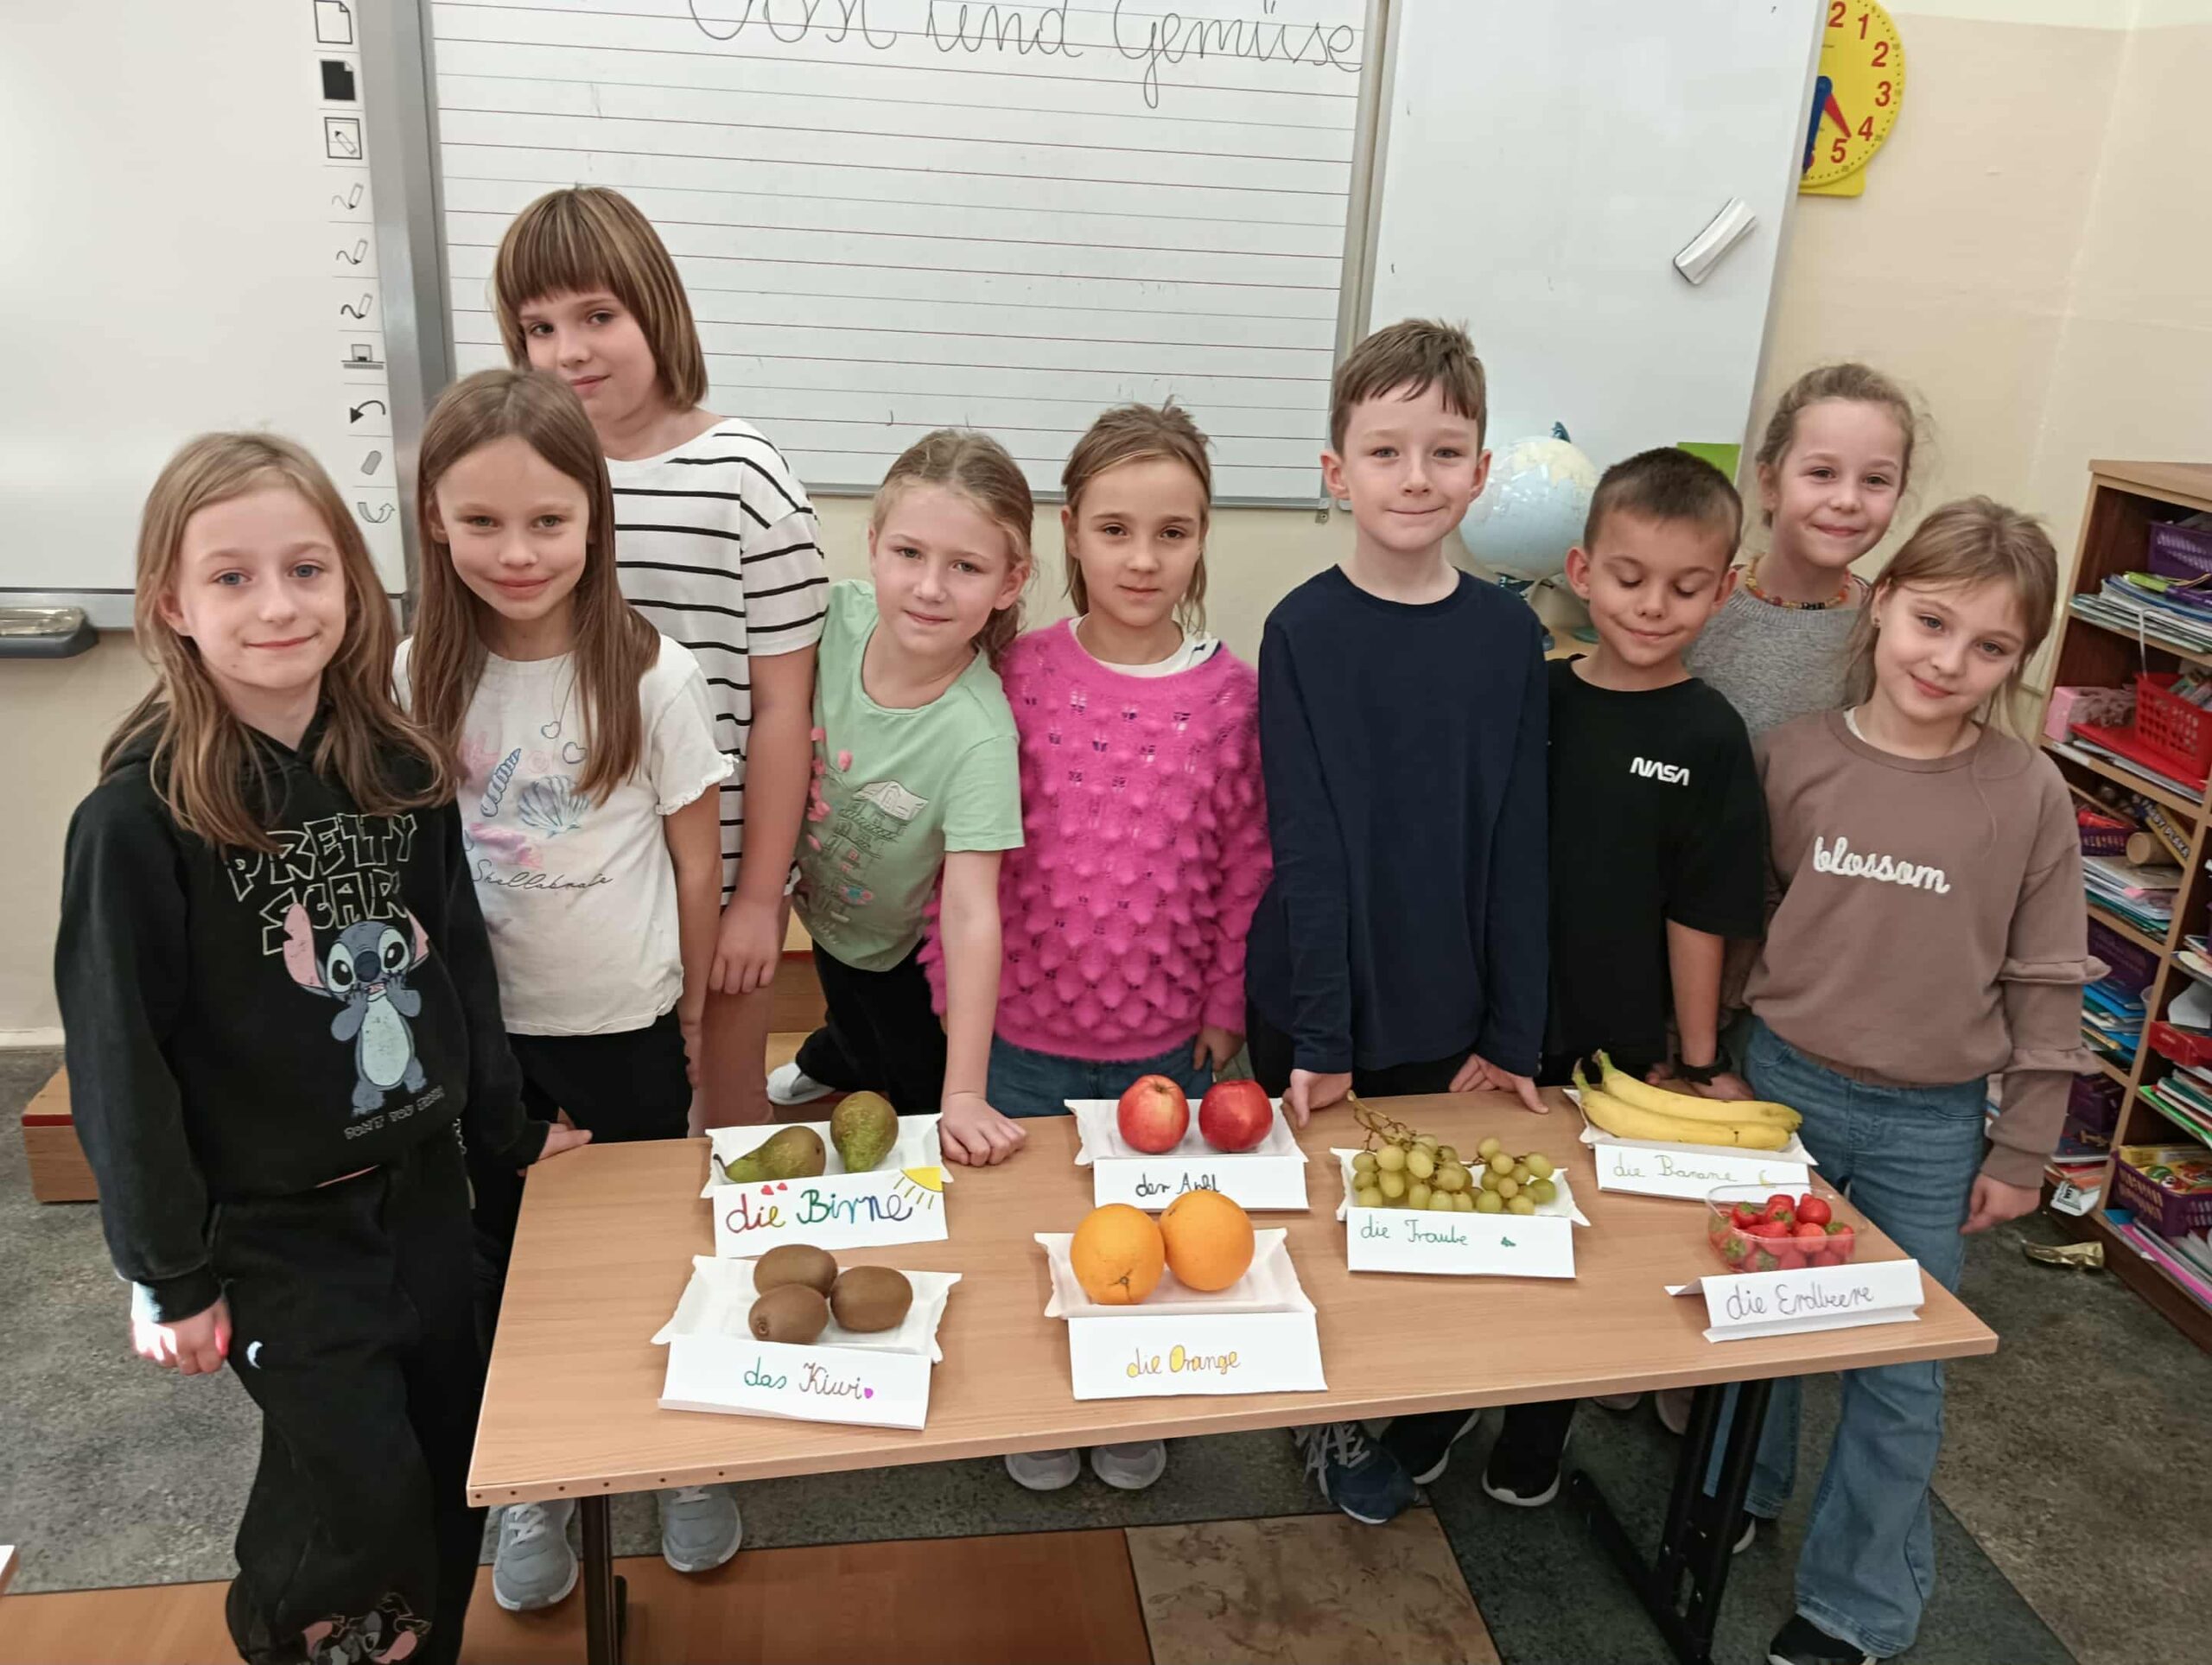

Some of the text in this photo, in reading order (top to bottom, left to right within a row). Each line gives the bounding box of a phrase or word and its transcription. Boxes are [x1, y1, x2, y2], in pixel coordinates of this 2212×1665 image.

[1827, 1, 1847, 29] 2
[1858, 13, 1870, 40] 1
[1114, 0, 1363, 109] Gemüse
[1871, 41, 1890, 67] 2
[1875, 80, 1892, 107] 3
[1858, 116, 1874, 142] 4
[1830, 137, 1848, 163] 5
[1630, 757, 1690, 786] NASA
[1813, 836, 1951, 894] blossom
[1613, 1153, 1646, 1179] die
[1135, 1172, 1171, 1197] der
[726, 1189, 913, 1234] die Birne
[1360, 1215, 1469, 1246] die Traube
[1726, 1282, 1875, 1320] die Erdbeere
[1126, 1344, 1242, 1377] die Orange
[743, 1357, 863, 1400] das Kiwi
